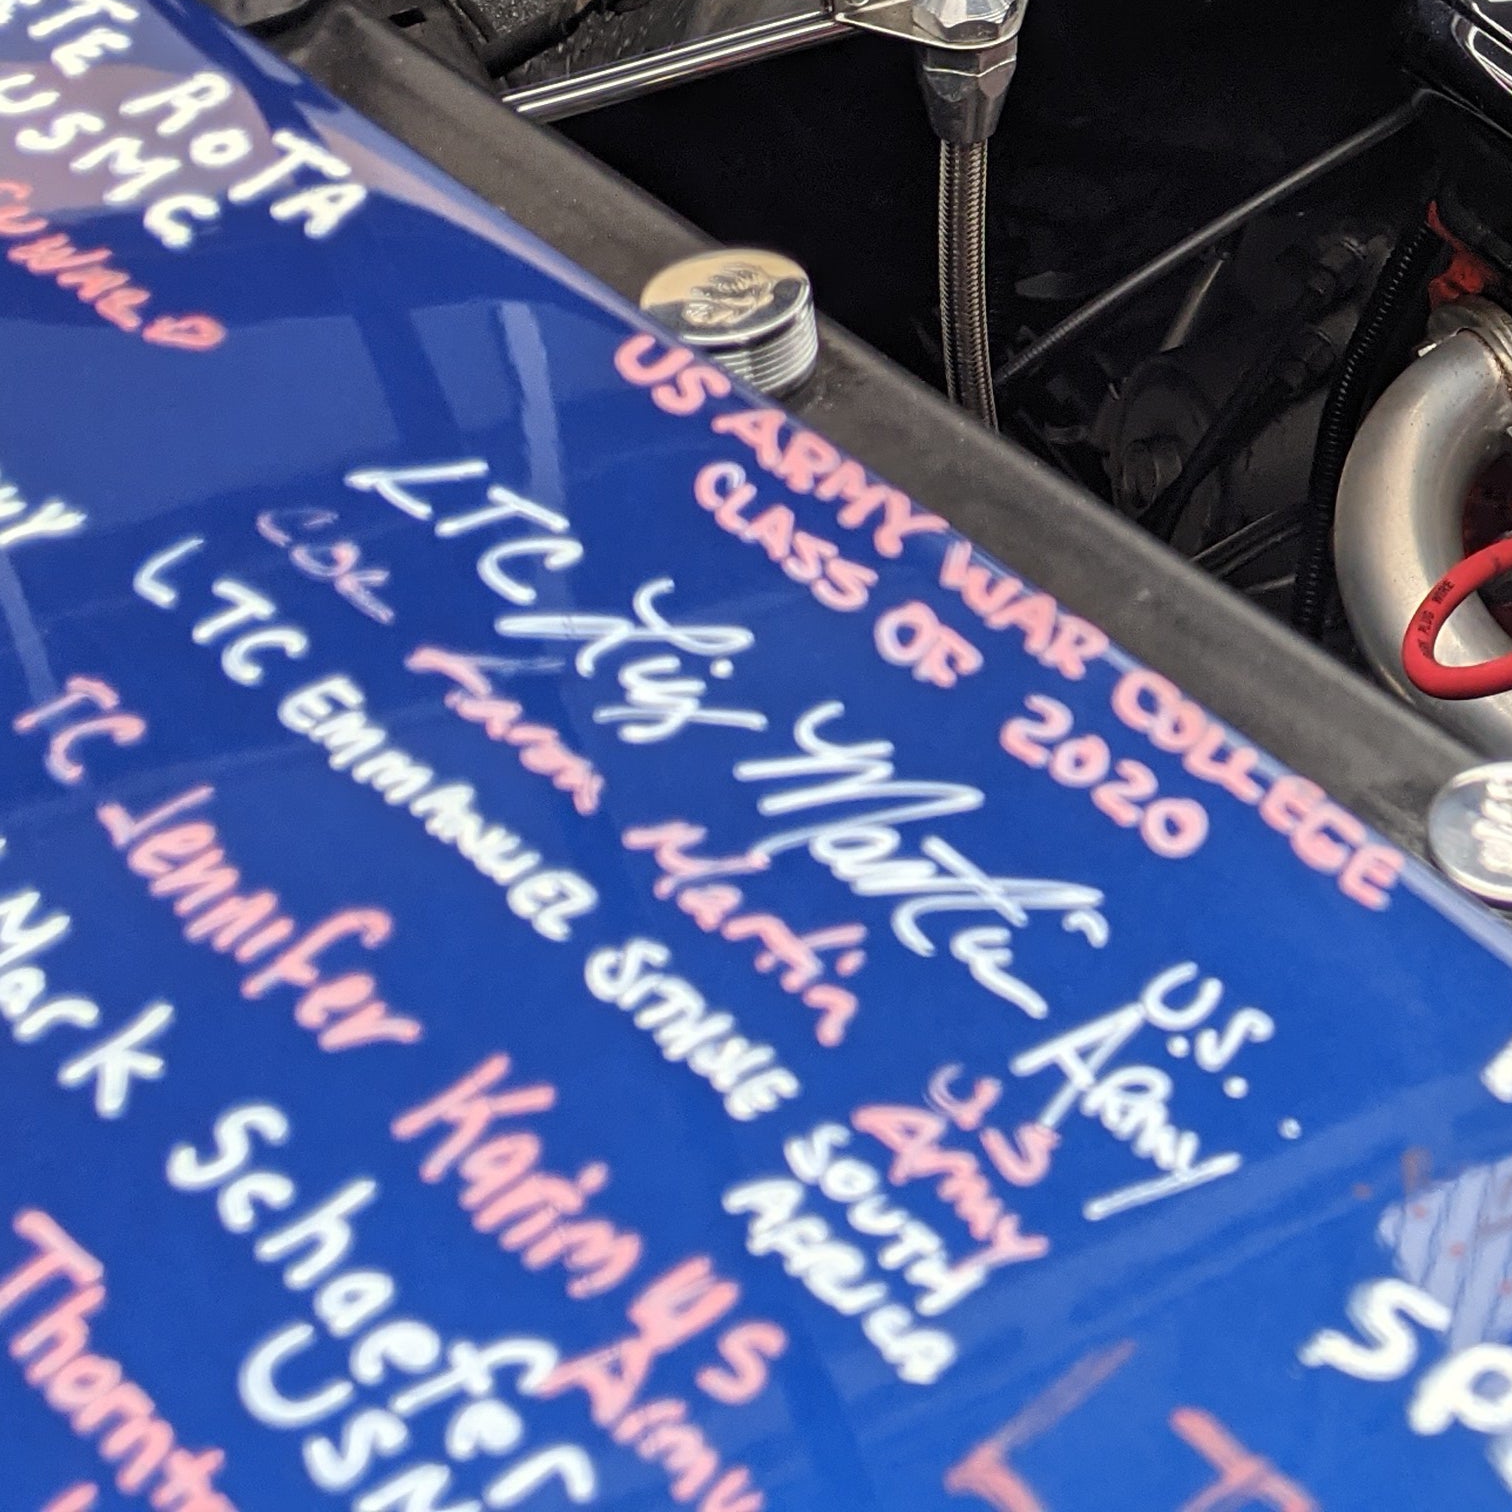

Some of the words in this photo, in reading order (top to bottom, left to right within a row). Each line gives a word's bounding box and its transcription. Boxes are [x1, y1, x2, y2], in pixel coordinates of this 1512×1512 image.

[0, 72, 222, 250] USMC
[117, 69, 369, 241] ROTA
[132, 537, 308, 686] LTC
[344, 459, 584, 605] LTC
[613, 333, 732, 416] US
[712, 409, 951, 558] ARMY
[937, 540, 1111, 680] WAR
[1111, 667, 1406, 912] COLLEGE
[694, 460, 879, 613] CLASS
[874, 600, 985, 688] OF
[999, 694, 1209, 859] 2020
[97, 784, 423, 1053] Jennifer
